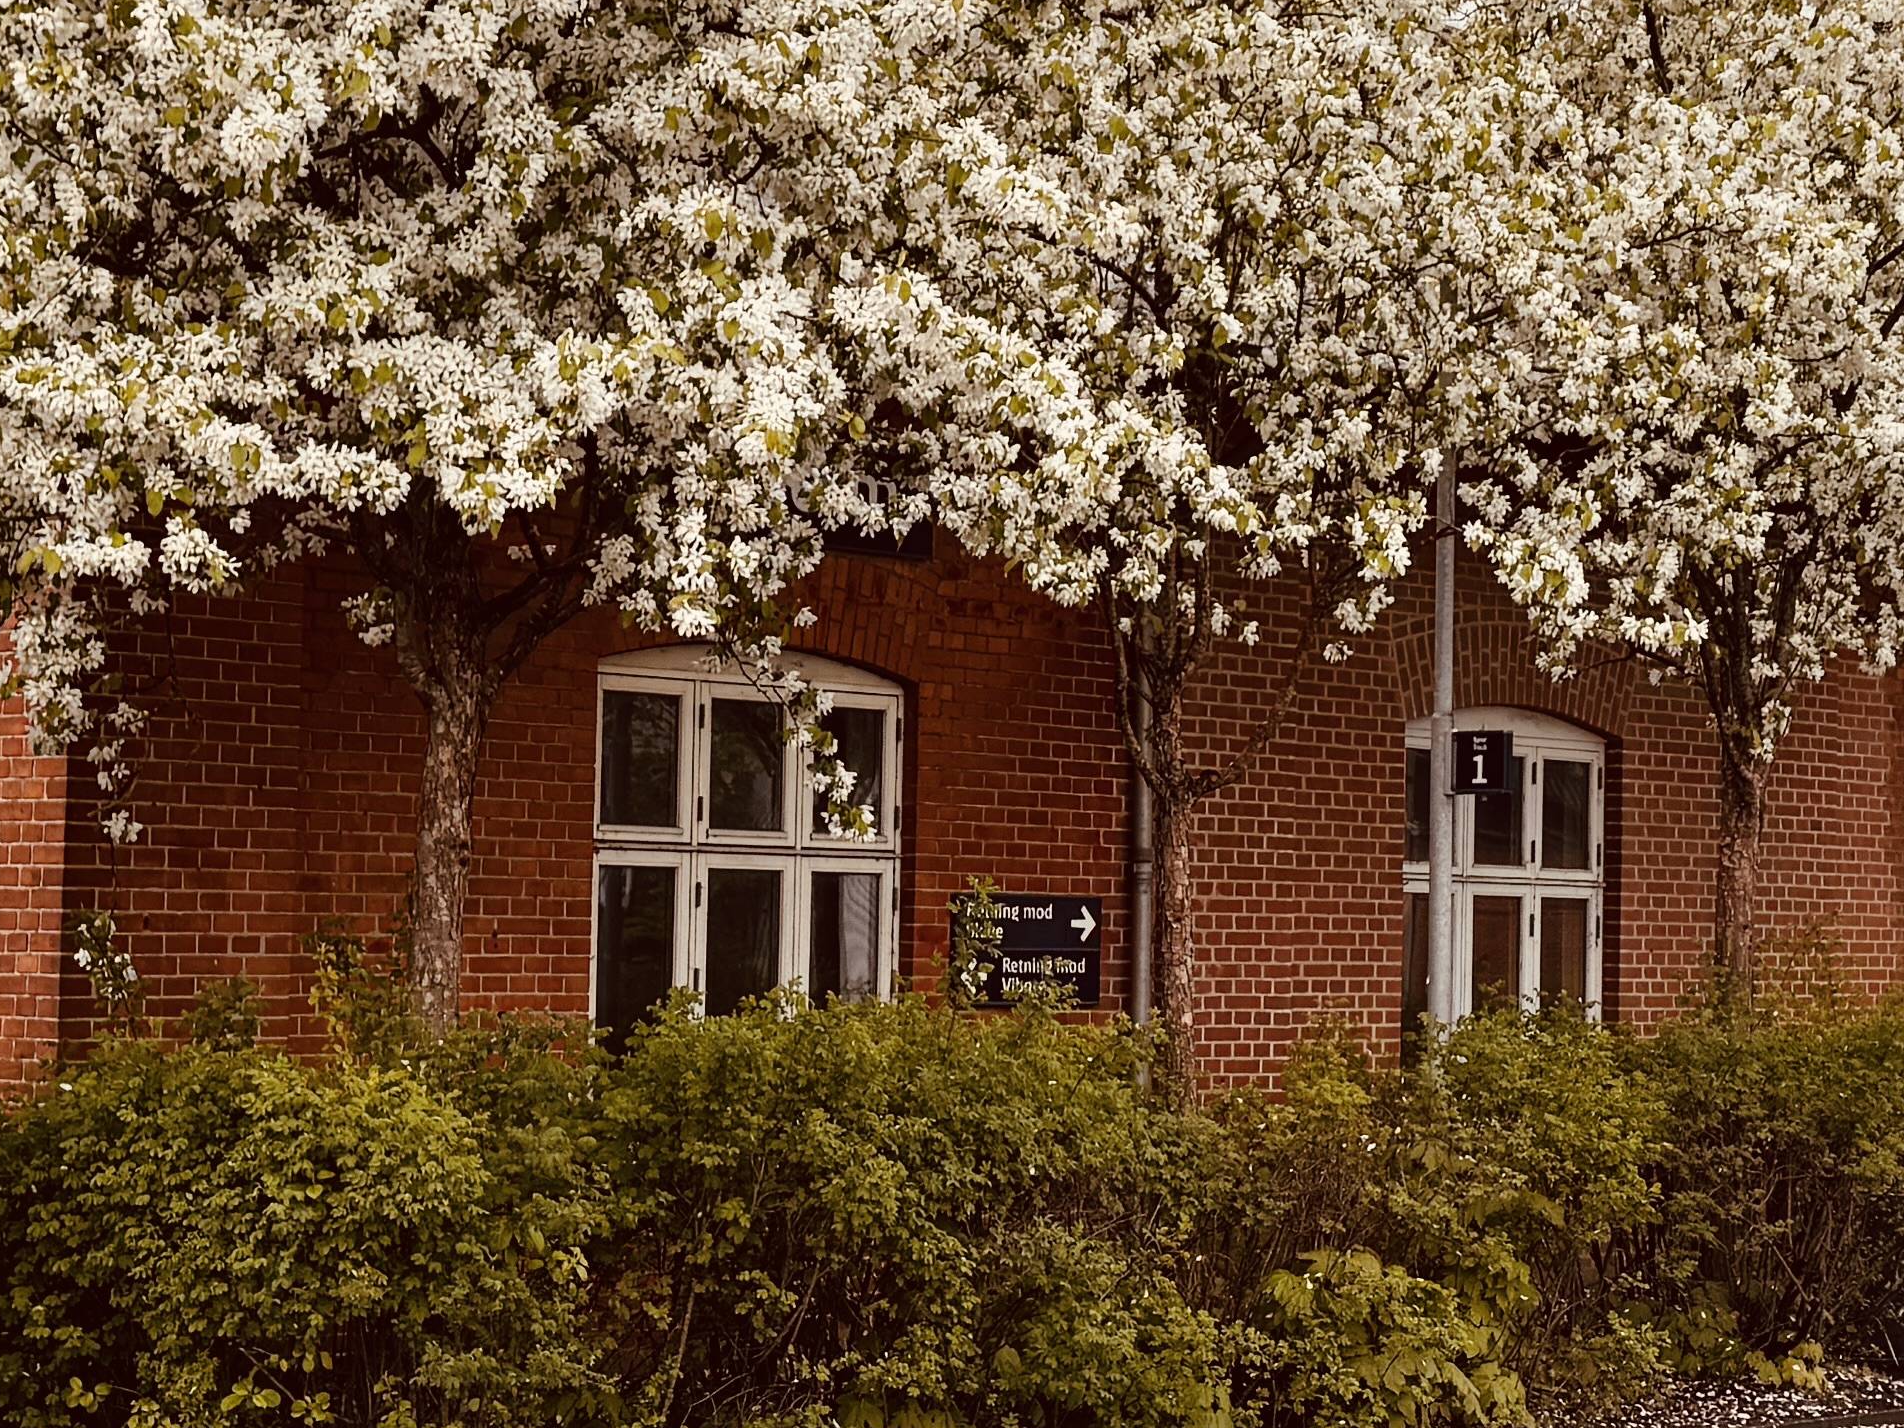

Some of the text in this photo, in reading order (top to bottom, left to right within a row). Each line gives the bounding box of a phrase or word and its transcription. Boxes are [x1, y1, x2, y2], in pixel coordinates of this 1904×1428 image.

[1472, 755, 1487, 784] 1
[967, 902, 1053, 922] Rtning mod
[1056, 957, 1086, 974] mod
